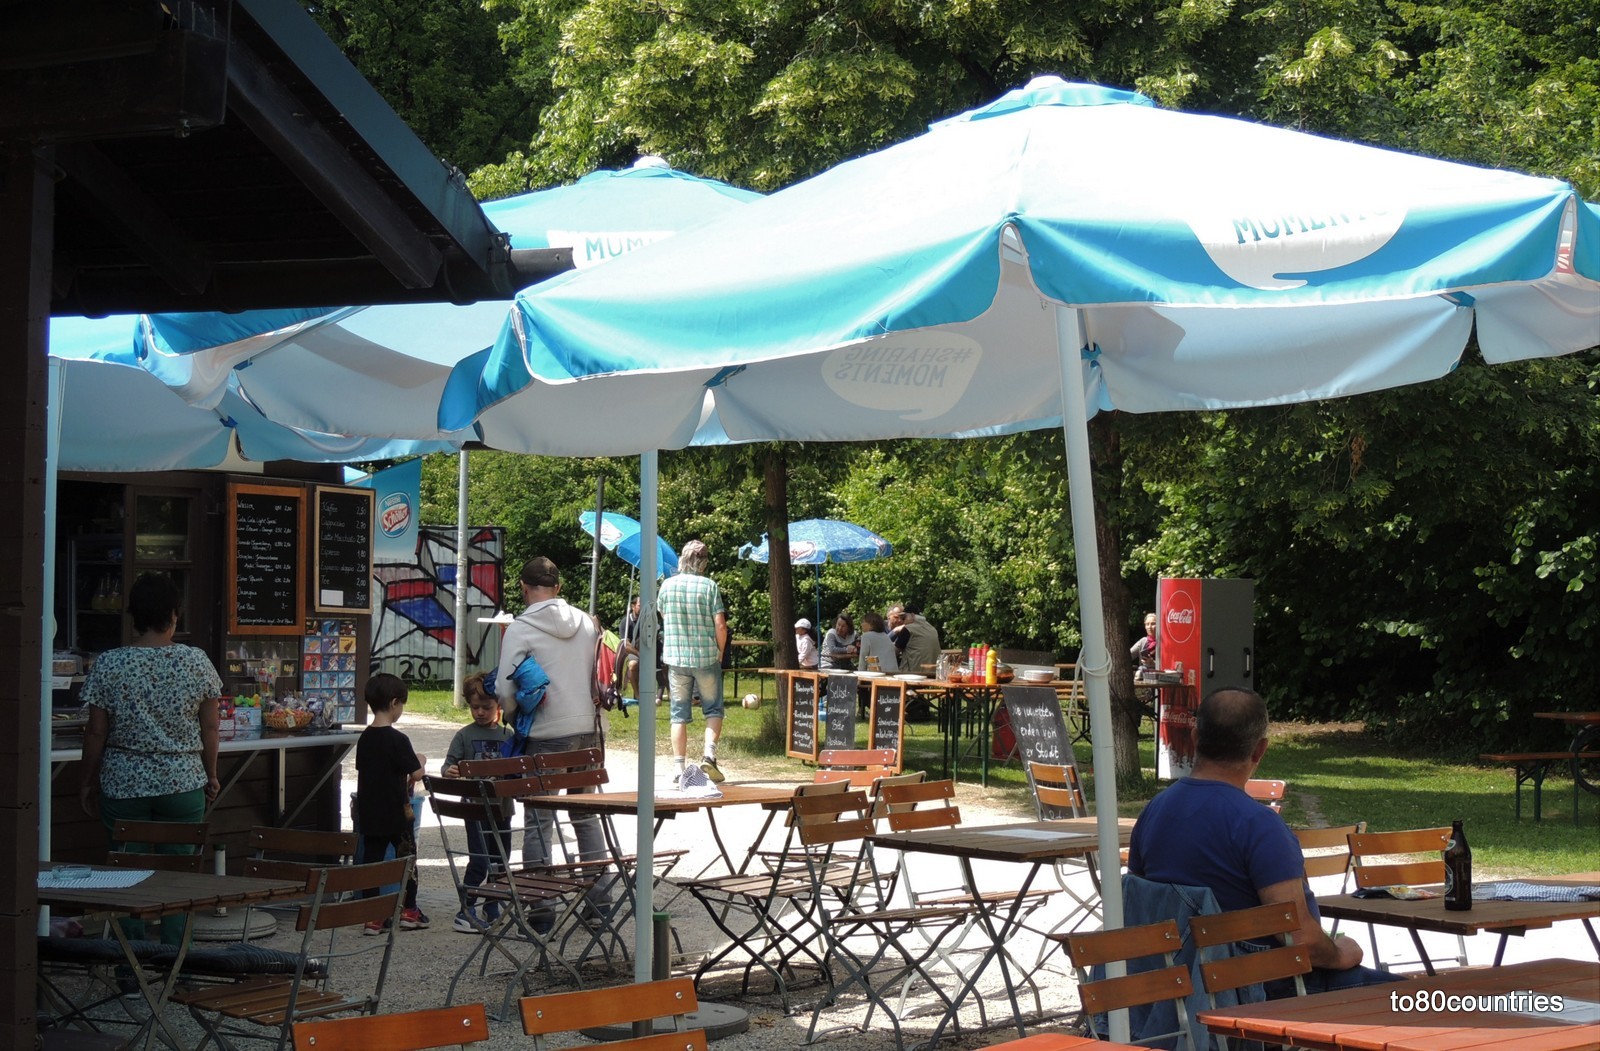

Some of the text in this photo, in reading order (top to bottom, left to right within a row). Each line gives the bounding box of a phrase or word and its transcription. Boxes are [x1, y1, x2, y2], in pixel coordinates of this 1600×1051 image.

[320, 574, 330, 585] Tee
[1167, 608, 1193, 624] Coca-Cola
[1035, 742, 1061, 759] Stadt
